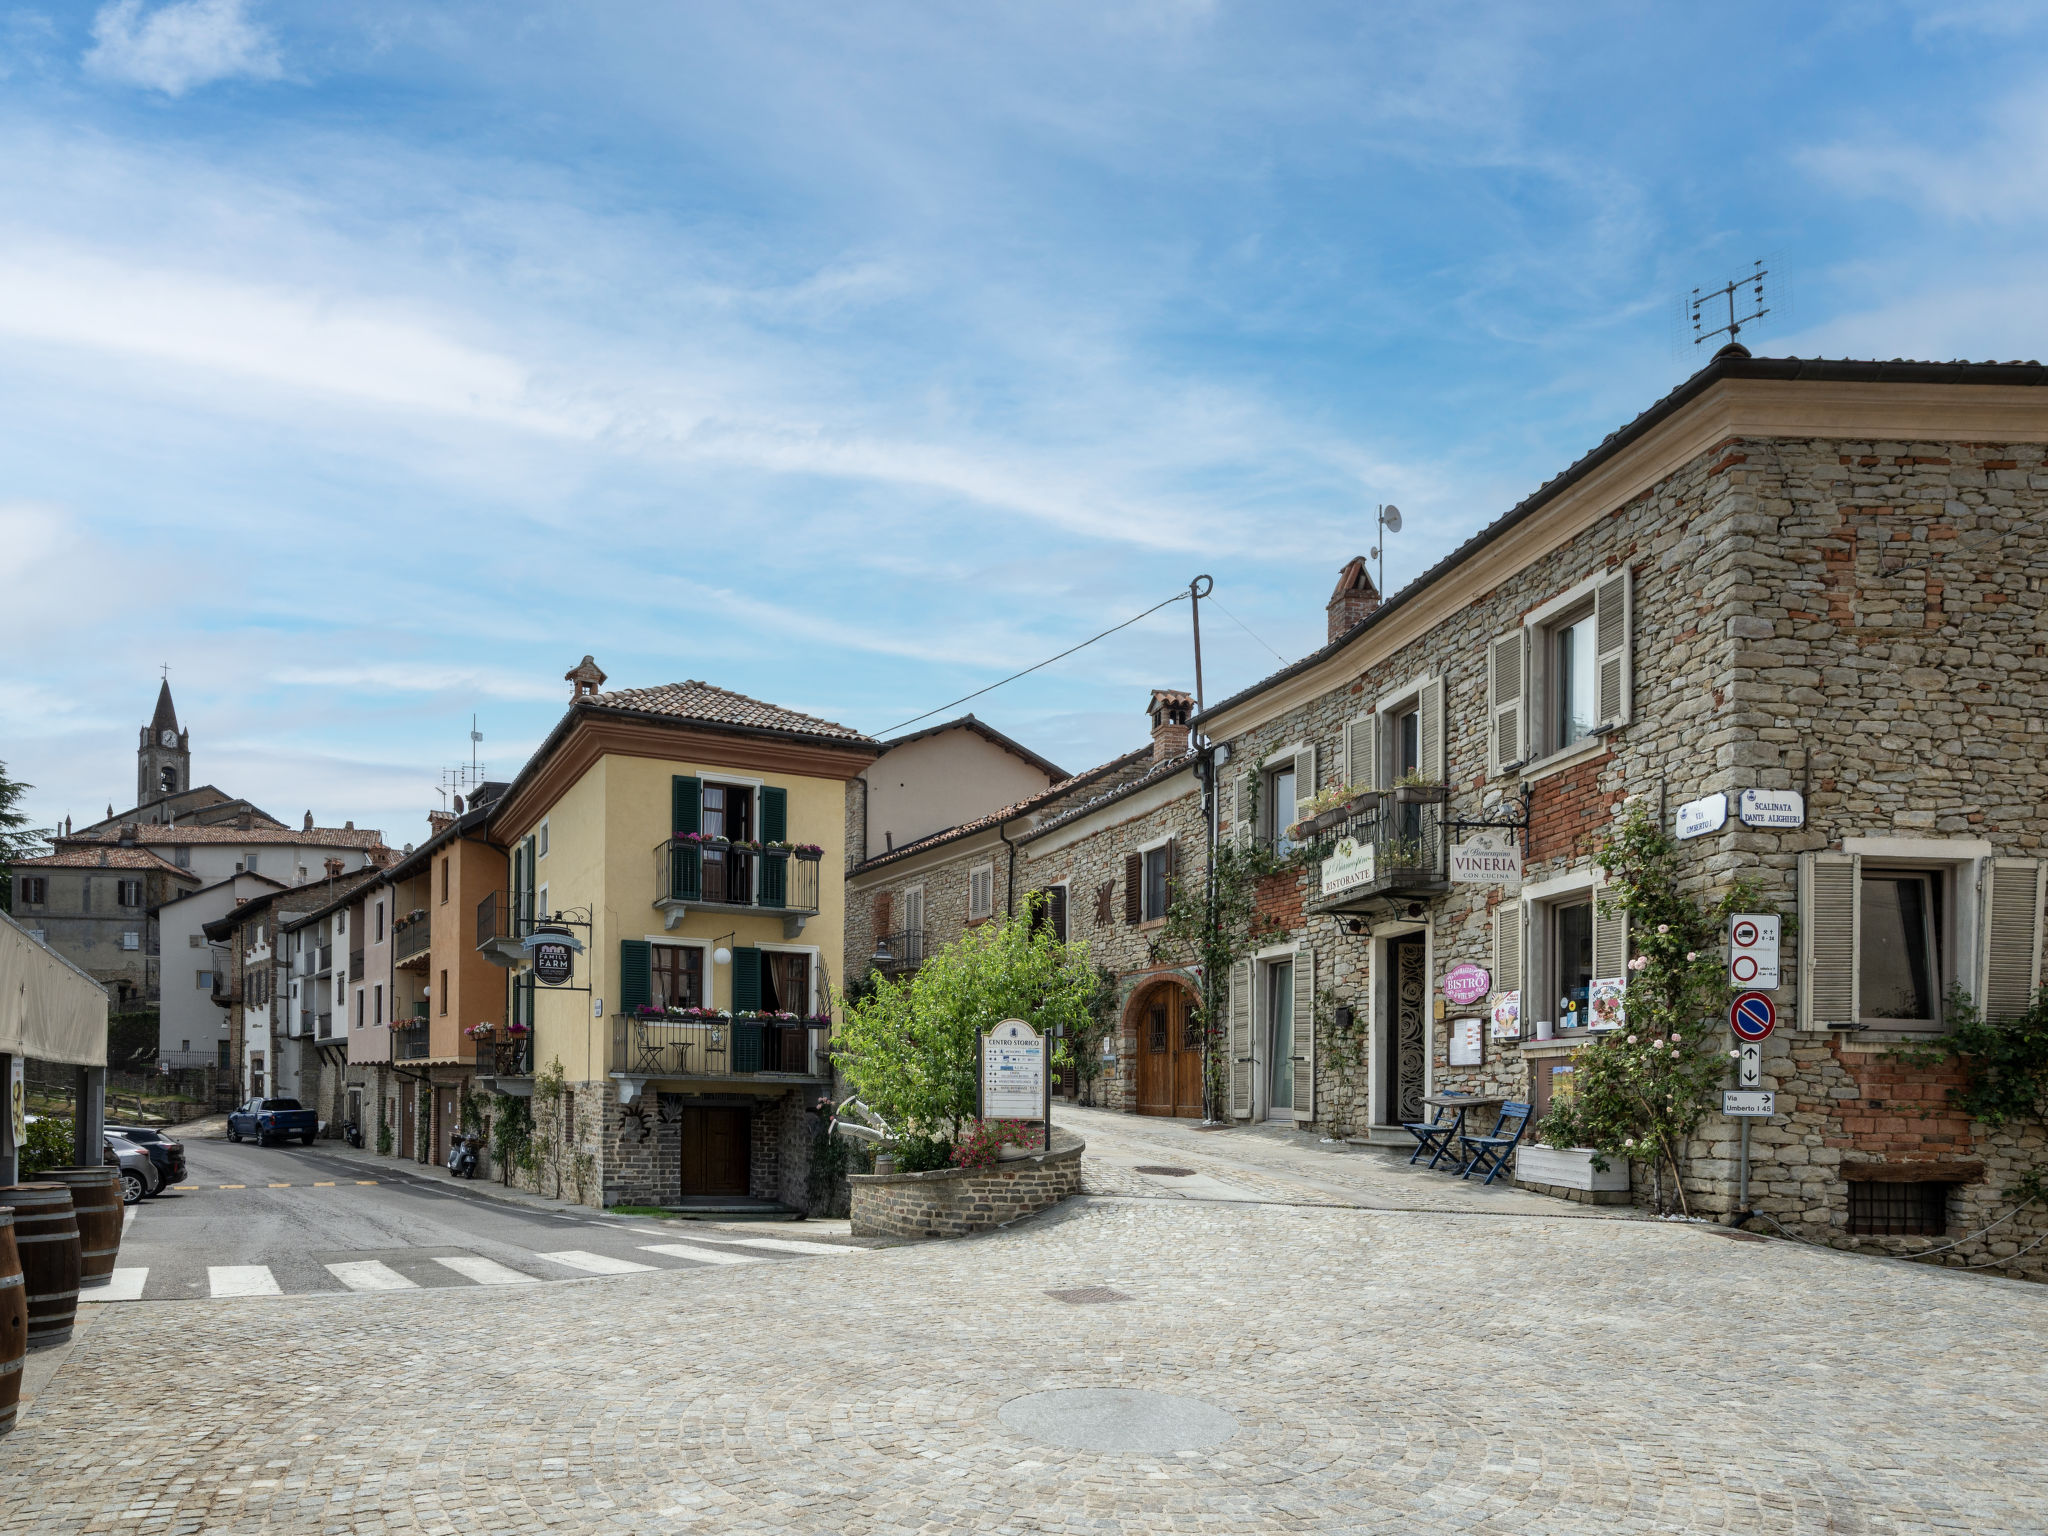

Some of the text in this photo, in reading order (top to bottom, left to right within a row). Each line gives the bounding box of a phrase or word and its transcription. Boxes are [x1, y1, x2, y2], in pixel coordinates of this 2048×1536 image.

[1755, 803, 1792, 812] SCALINATA
[1695, 812, 1704, 820] VIA
[1745, 814, 1800, 824] DANTE ALIGHIERI
[1686, 821, 1708, 834] UMBERTO
[1455, 857, 1516, 871] VINERIA
[1326, 869, 1370, 891] RISTORANTE
[539, 959, 568, 968] FARM
[1447, 977, 1484, 989] BISTRO
[1013, 1039, 1040, 1047] STORICO
